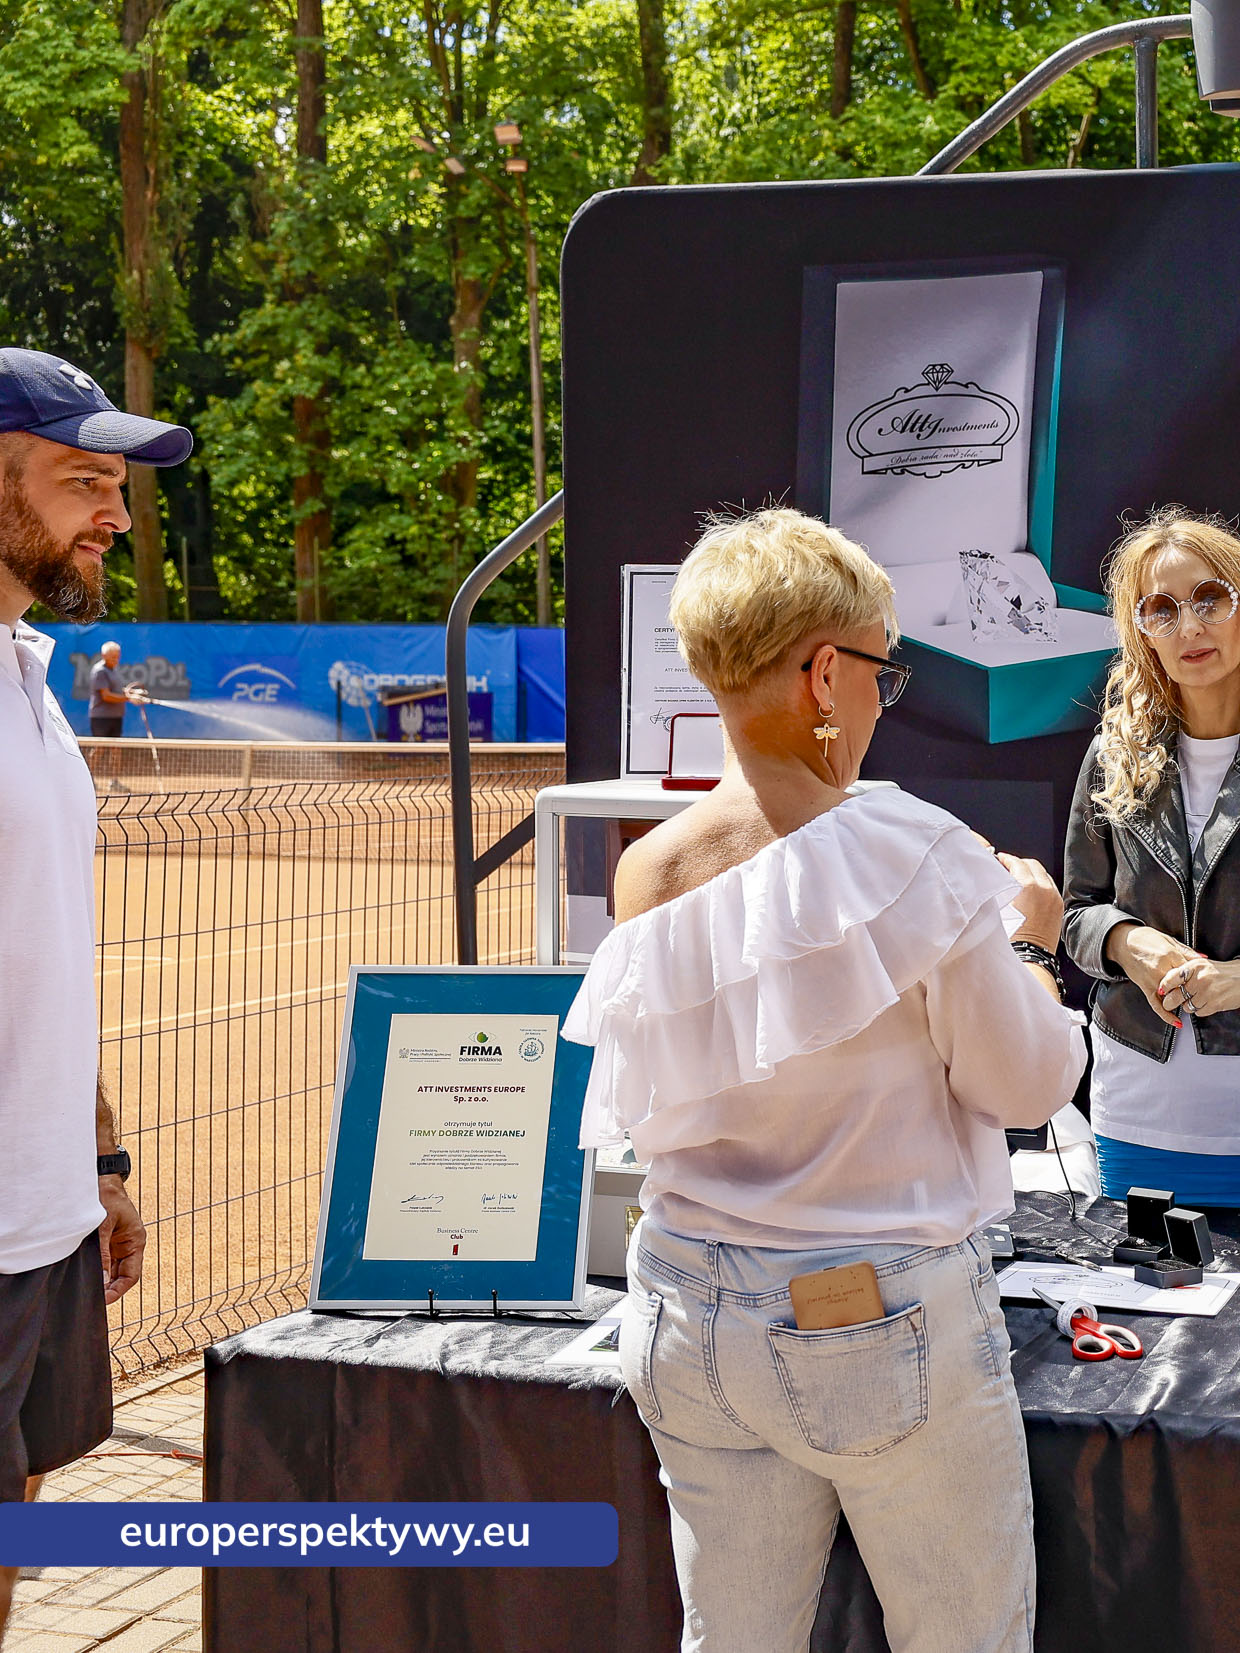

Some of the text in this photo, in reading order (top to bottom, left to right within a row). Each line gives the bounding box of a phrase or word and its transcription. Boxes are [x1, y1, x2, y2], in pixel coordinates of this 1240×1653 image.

[231, 682, 280, 702] PGE
[460, 1046, 502, 1056] FIRMA
[454, 1096, 466, 1104] Sp.
